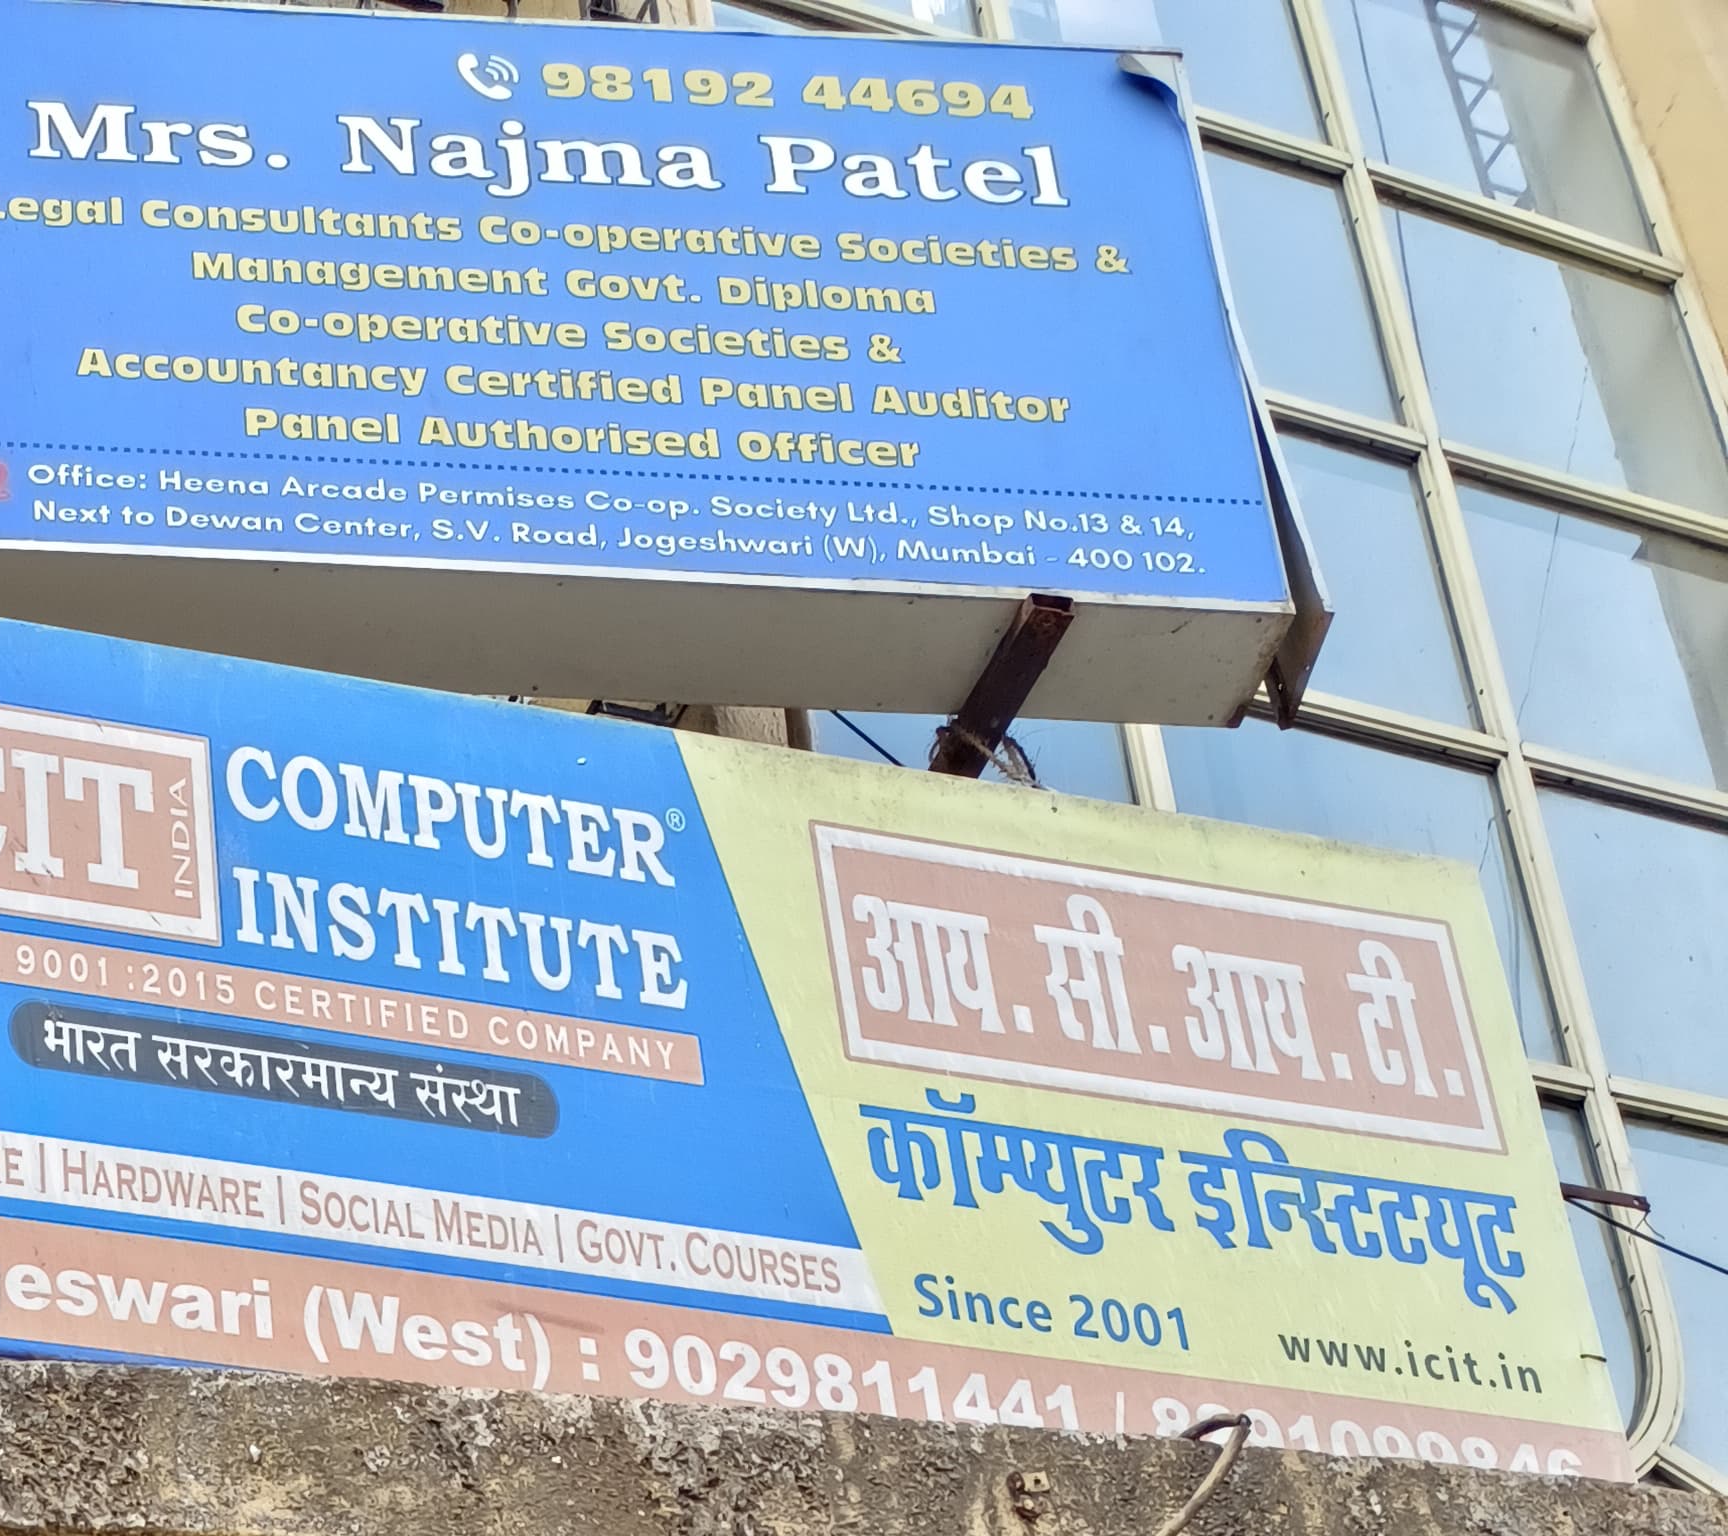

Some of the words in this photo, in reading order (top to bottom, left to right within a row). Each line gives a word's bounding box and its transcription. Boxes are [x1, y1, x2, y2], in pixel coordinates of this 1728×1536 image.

[540, 62, 775, 108] 98192
[800, 74, 1035, 121] 44694
[25, 99, 290, 171] Mrs.
[337, 113, 726, 198] Najma
[757, 133, 1071, 206] Patel
[140, 197, 463, 243] Consultants
[478, 214, 823, 262] Co-operative
[838, 231, 1079, 272] Societies
[1093, 244, 1132, 276] &
[191, 250, 550, 298] Management
[566, 267, 702, 304] Govt.
[717, 274, 937, 315] Diploma
[235, 303, 588, 351] Co-operative
[603, 320, 850, 362] Societies
[867, 332, 906, 364] &
[76, 346, 428, 397] Accountancy
[444, 361, 684, 406] Certified
[700, 374, 855, 413] Panel
[870, 383, 1071, 423] Auditor
[243, 406, 401, 445] Panel
[418, 414, 721, 460] Authorised
[738, 430, 922, 468] Officer
[26, 462, 148, 492] Office:
[158, 469, 270, 498] Heena
[280, 475, 408, 504] Arcade
[418, 482, 575, 513] Permises
[584, 490, 700, 523] Co-op.
[710, 495, 836, 528] Society
[846, 500, 919, 531] Ltd.,
[927, 504, 1015, 537] Shop
[1022, 508, 1110, 536] No.13
[1118, 511, 1145, 537] &
[1149, 513, 1196, 542] 14,
[32, 499, 112, 526] Next
[119, 503, 157, 529] to
[165, 506, 285, 533] Dewan
[293, 512, 423, 543] Center,
[431, 516, 502, 543] S.V.
[512, 523, 610, 552] Road,
[617, 526, 814, 558] Jogeshwari
[822, 534, 888, 566] (W),
[896, 536, 1037, 569] Mumbai
[1066, 546, 1134, 573] 400
[1141, 548, 1208, 576] 102.
[170, 776, 195, 900] INDIA
[232, 867, 689, 1010] INSTITUTE
[16, 944, 110, 987] 9001
[253, 980, 470, 1042] CERTIFIED
[487, 1018, 676, 1072] COMPANY
[43, 1017, 142, 1073] भारत
[151, 1033, 399, 1111] सरकारमान्य
[410, 1062, 522, 1127] संस्था
[857, 1087, 1177, 1256] कॉम्प्युटर
[61, 1147, 264, 1218] HARDWARE
[300, 1179, 425, 1240] SOCIAL
[433, 1198, 544, 1258] MEDIA
[576, 1220, 677, 1272] GOVT.
[685, 1232, 842, 1294] COURSES
[912, 1272, 1053, 1332] Since
[1069, 1293, 1193, 1351] 2001
[302, 1284, 550, 1391] (West)
[624, 1326, 1080, 1434] 9029811441
[1279, 1329, 1544, 1395] www.icit.in
